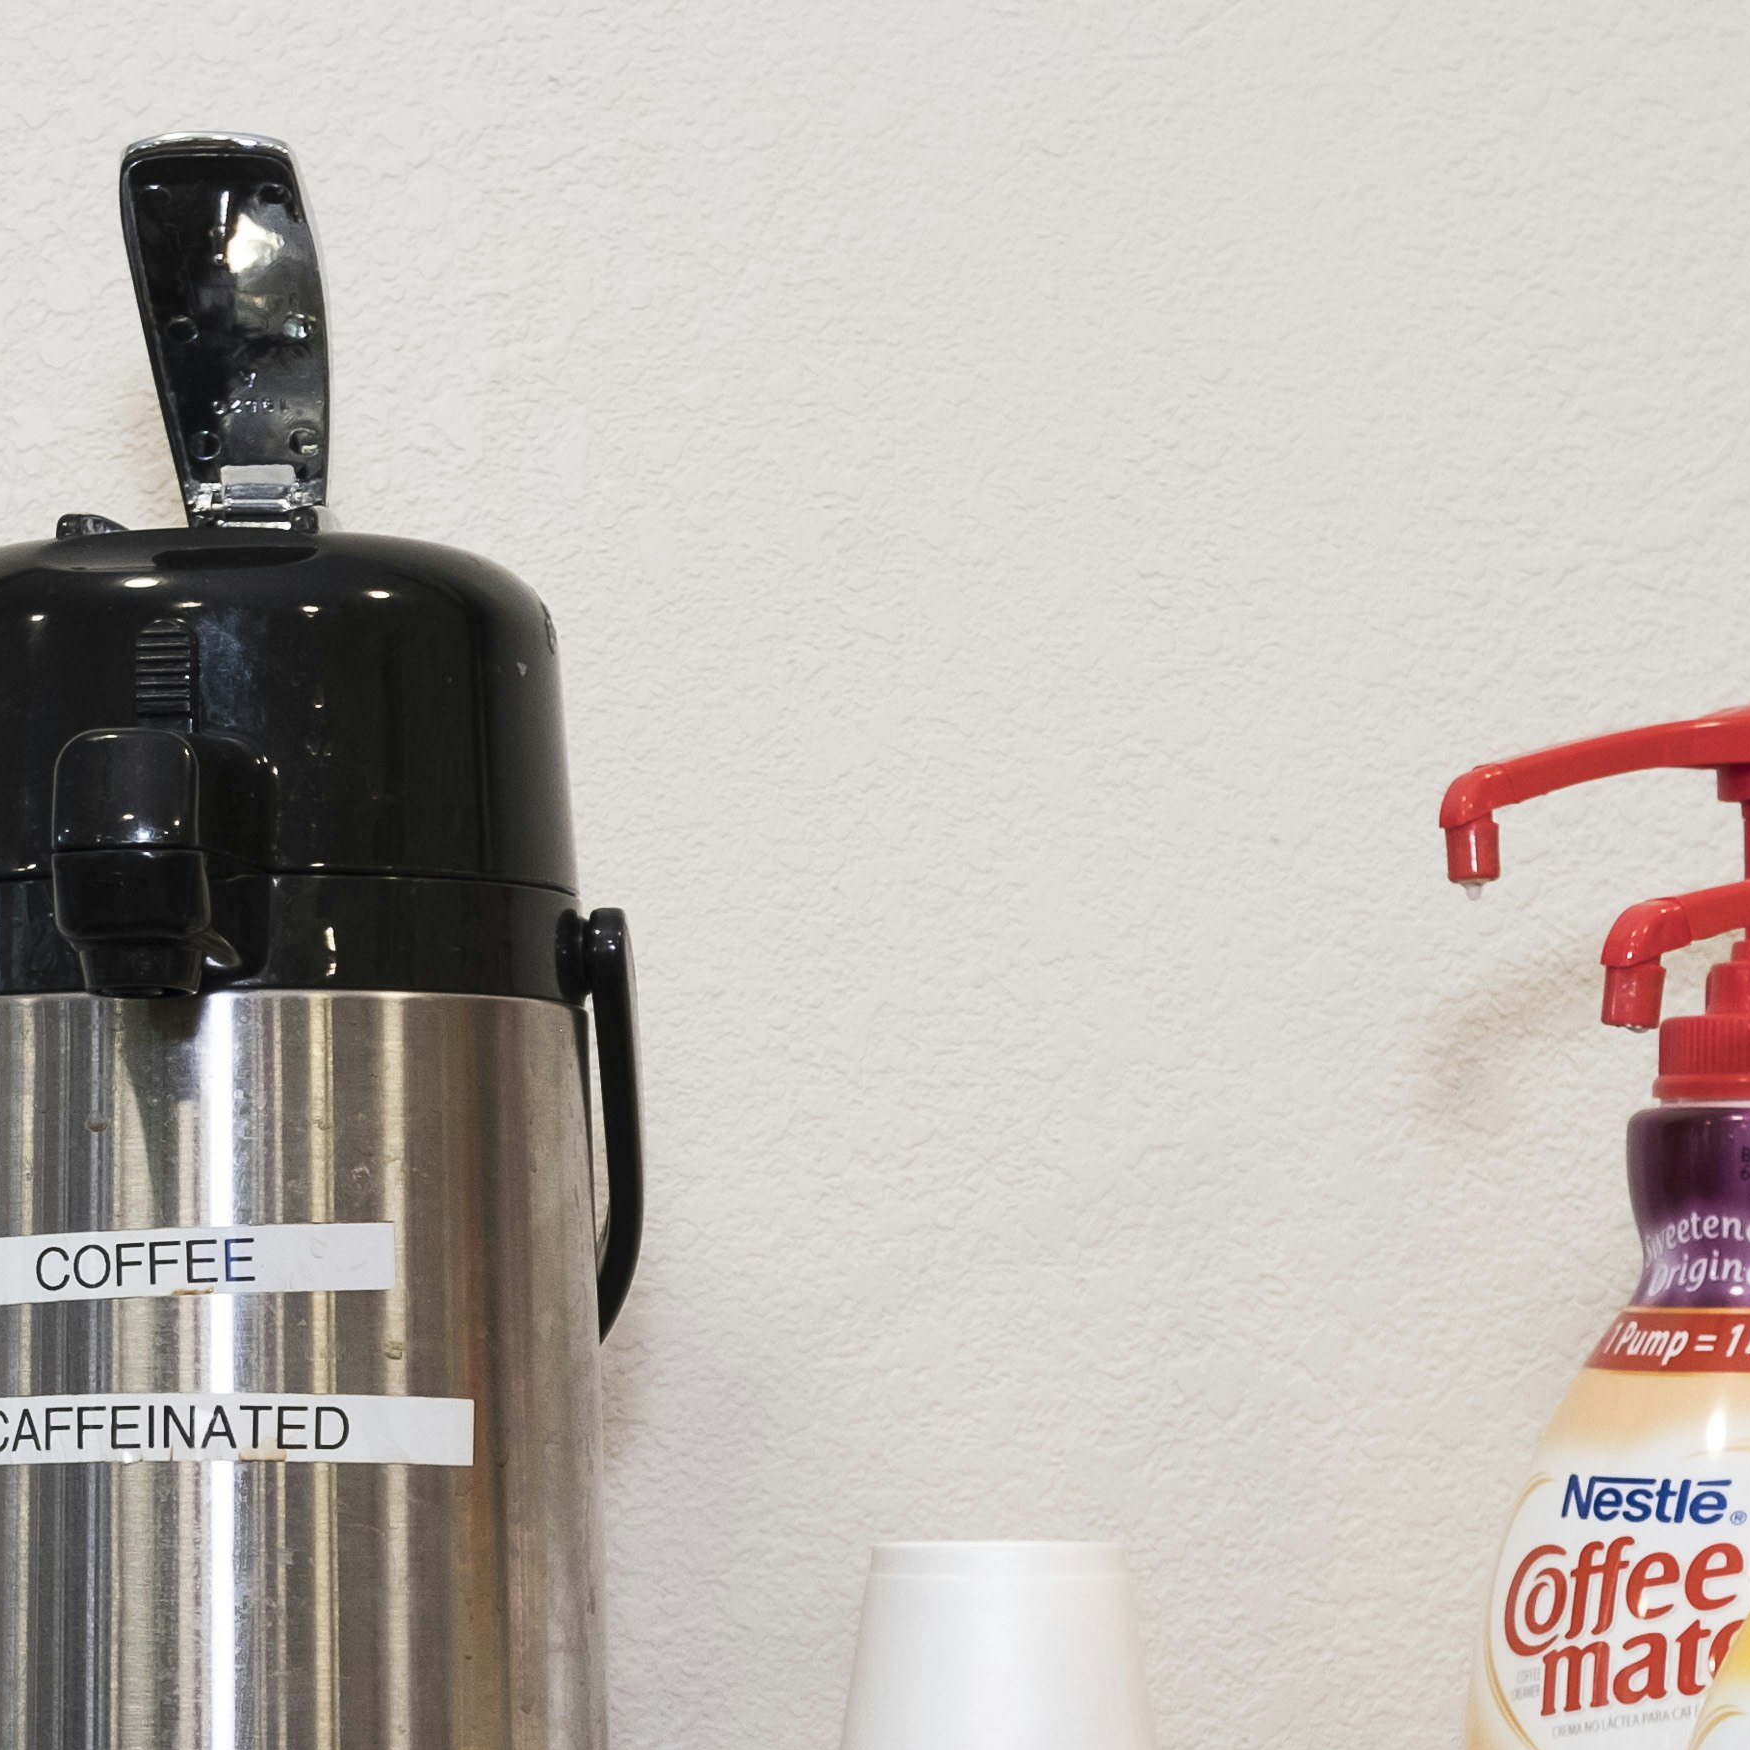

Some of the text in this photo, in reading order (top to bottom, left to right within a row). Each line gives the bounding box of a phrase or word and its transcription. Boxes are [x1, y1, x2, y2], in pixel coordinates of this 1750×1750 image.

[36, 1238, 256, 1291] COFFEE
[1614, 1321, 1690, 1366] Pump
[1725, 1323, 1745, 1358] 1
[1642, 1710, 1670, 1727] PARA
